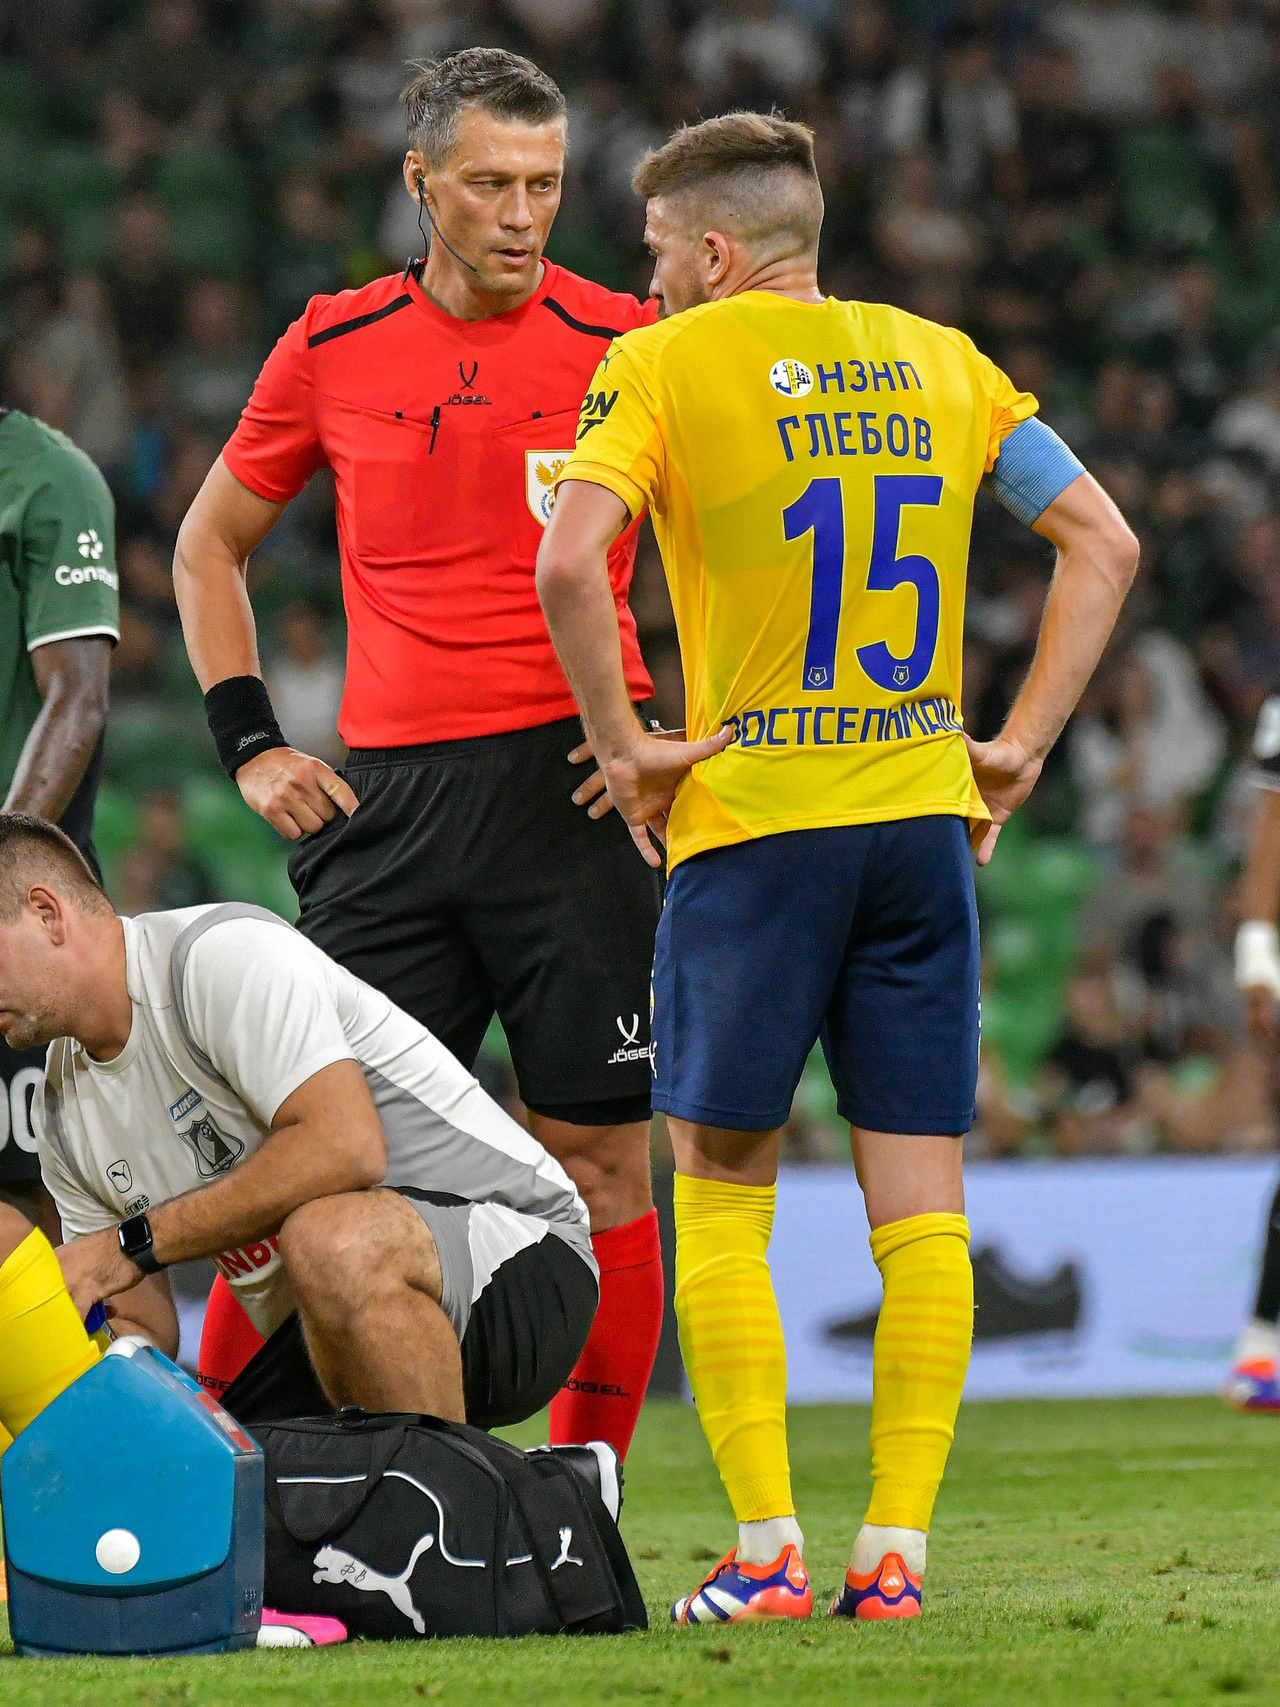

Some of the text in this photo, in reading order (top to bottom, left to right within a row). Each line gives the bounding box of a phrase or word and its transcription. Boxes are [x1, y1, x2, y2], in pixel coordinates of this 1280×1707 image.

[816, 360, 923, 394] НЗНП
[442, 394, 493, 406] JÖGEL
[581, 390, 619, 418] ON
[776, 411, 933, 462] ГЛЕБОВ
[781, 474, 944, 694] 15
[237, 731, 270, 752] JÖGEL
[607, 1047, 650, 1064] JÖGE
[564, 1378, 630, 1397] ÖGEL
